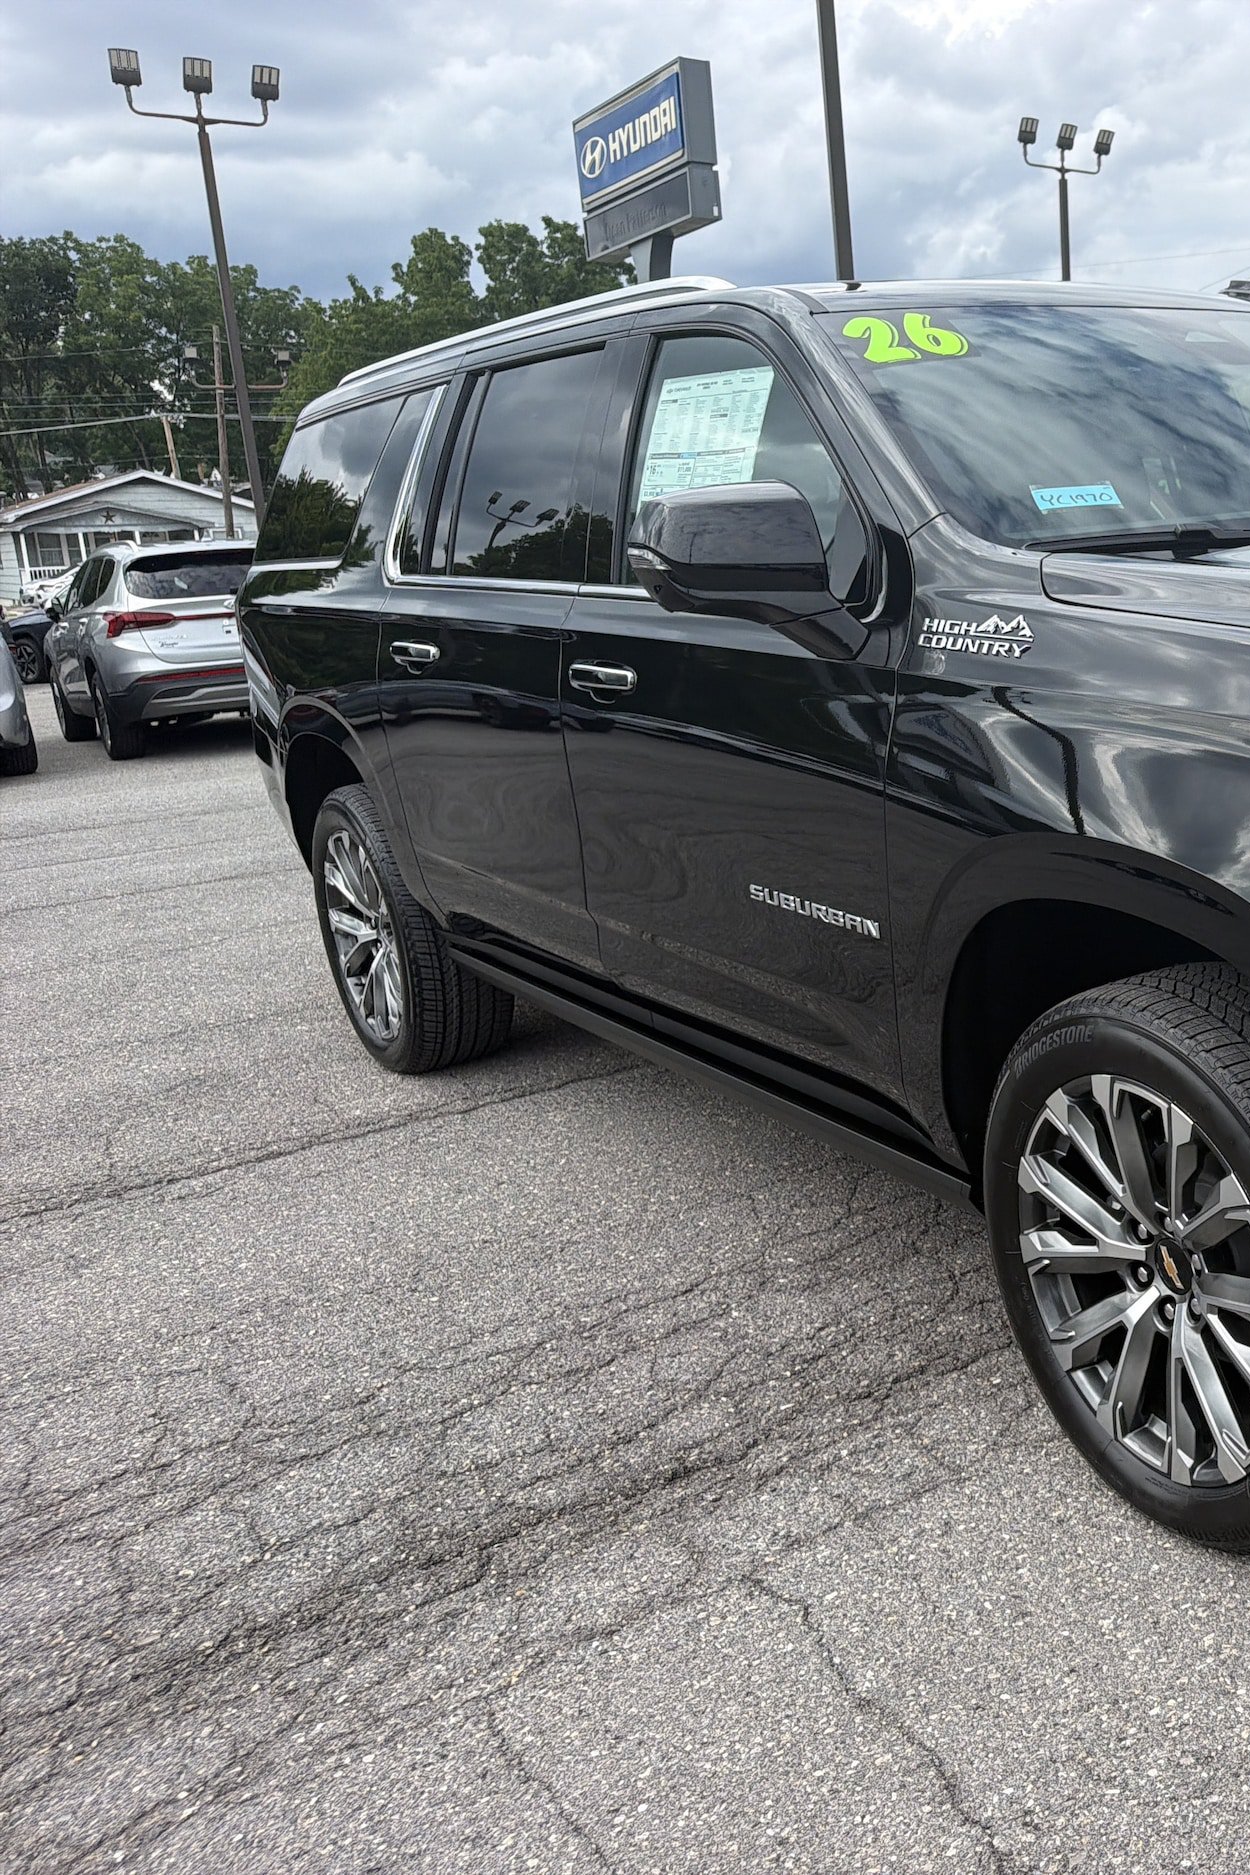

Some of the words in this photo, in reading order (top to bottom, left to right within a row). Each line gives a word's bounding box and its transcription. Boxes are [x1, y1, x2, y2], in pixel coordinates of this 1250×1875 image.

[608, 96, 677, 164] HYUNDAI
[842, 312, 969, 363] 26
[918, 633, 1032, 659] COUNTRY
[922, 617, 978, 636] HIGH
[749, 883, 881, 940] SUBURBAN
[1013, 1024, 1095, 1079] BRIDGESTONE
